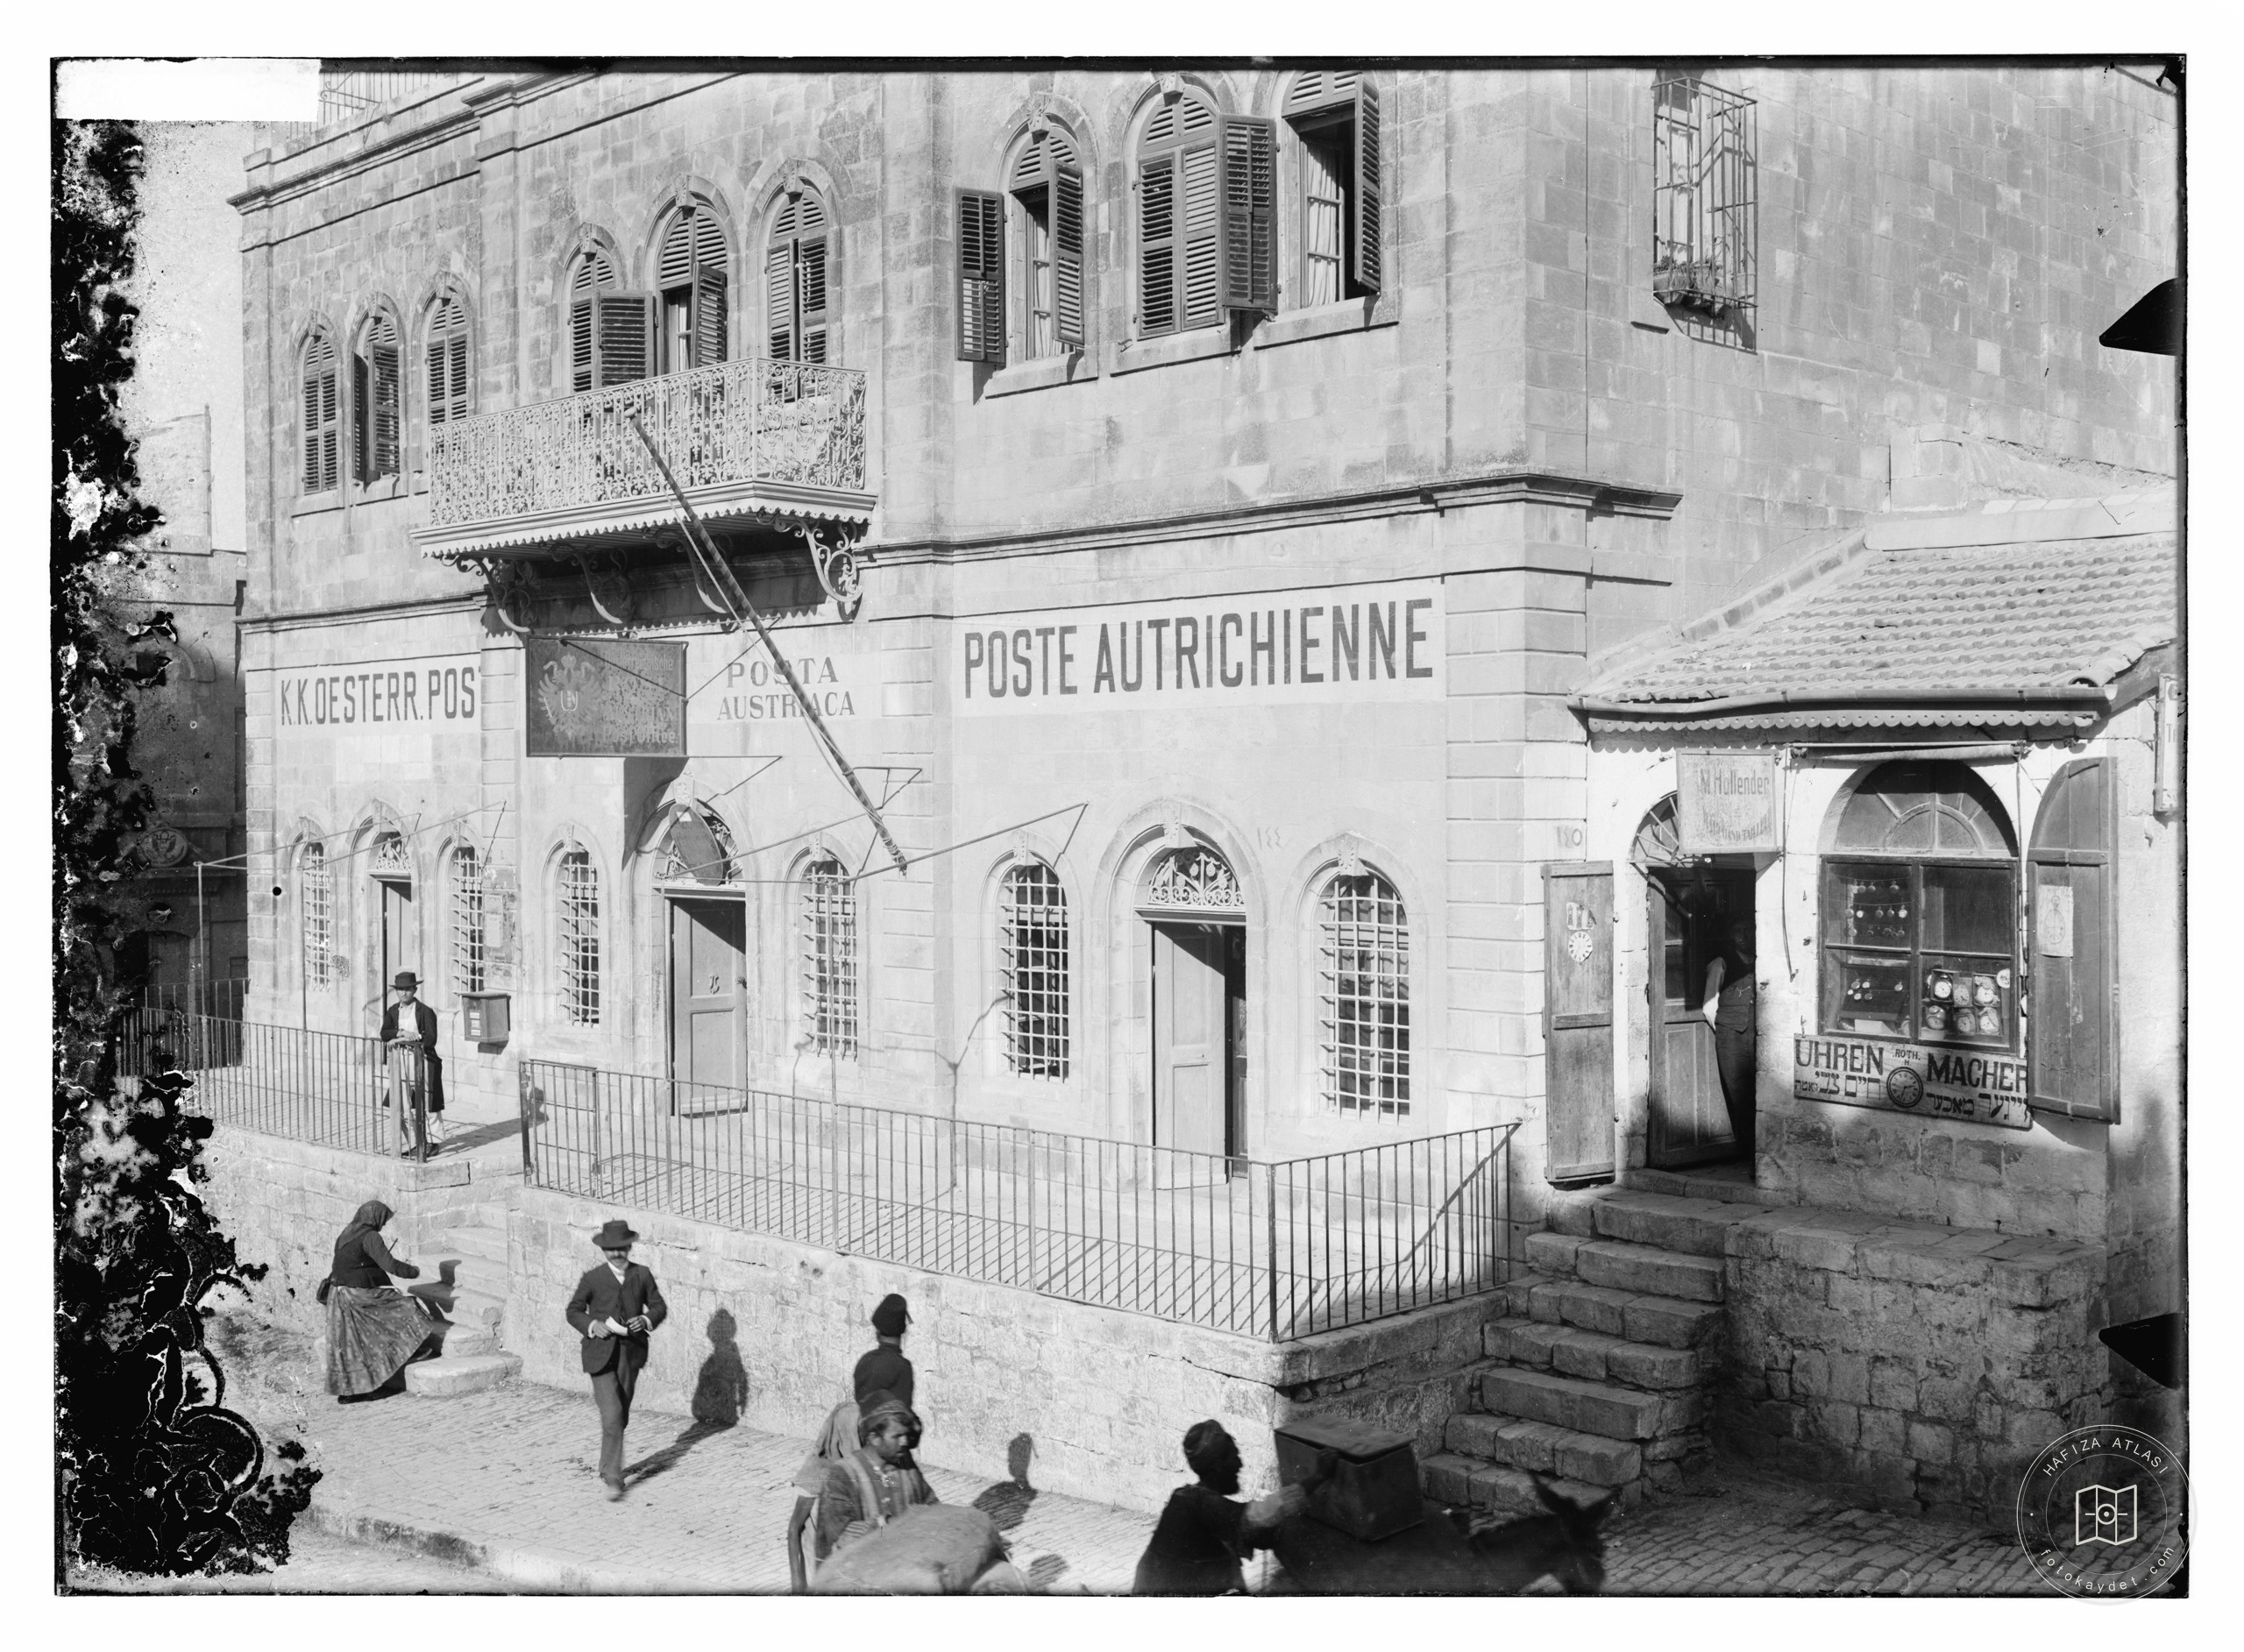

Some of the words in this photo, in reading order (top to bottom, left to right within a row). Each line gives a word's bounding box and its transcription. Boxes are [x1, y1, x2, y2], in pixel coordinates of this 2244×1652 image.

[965, 624, 1078, 699] POSTE
[1093, 598, 1433, 694] AUTRICHIENNE
[717, 690, 856, 720] AUSTRACA
[1714, 768, 1770, 796] Hollender
[1794, 1039, 1885, 1076] UHREN
